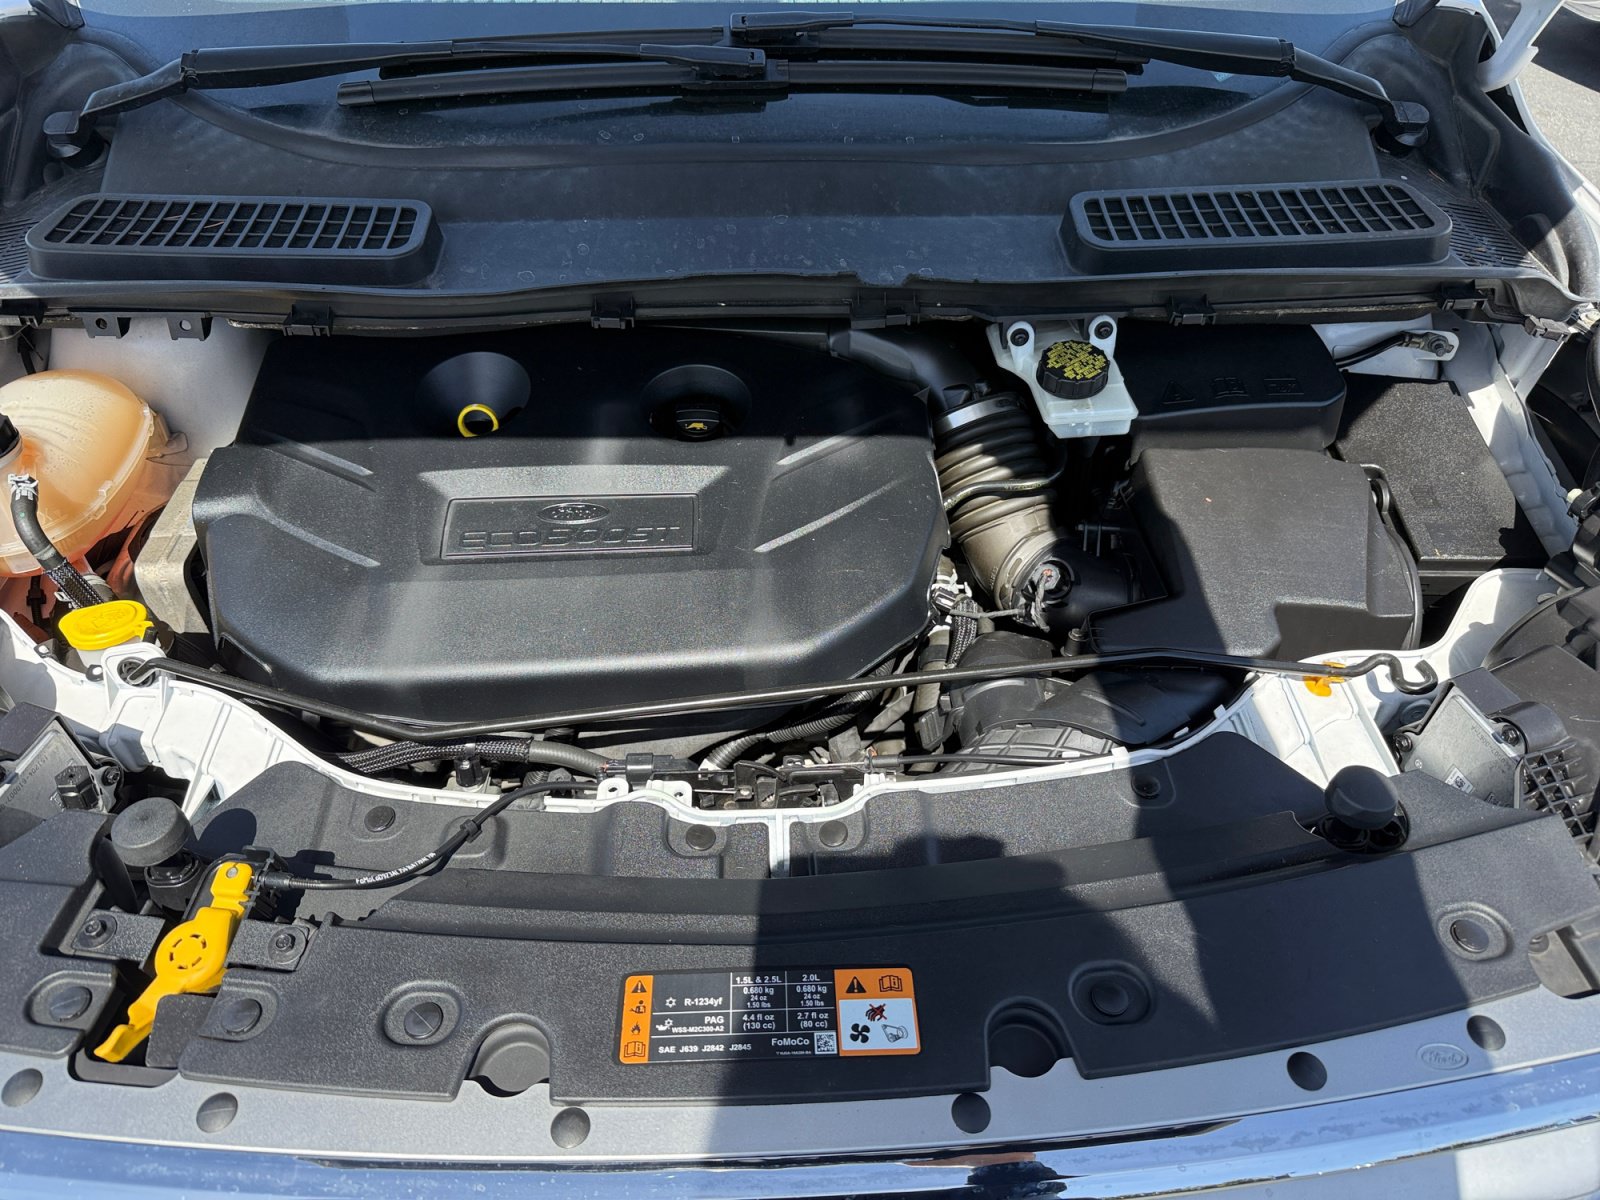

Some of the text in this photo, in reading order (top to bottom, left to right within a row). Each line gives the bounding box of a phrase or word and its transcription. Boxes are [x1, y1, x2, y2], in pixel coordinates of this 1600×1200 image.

[735, 975, 782, 984] 1.5L & 2.5L
[802, 974, 820, 982] 2.0L
[764, 987, 774, 995] kg
[796, 985, 827, 993] 0.680 kg
[684, 997, 723, 1008] R-1234yf
[704, 1015, 725, 1024] PAG
[756, 1013, 763, 1021] fl
[743, 1021, 776, 1031] (130 cc)
[800, 1020, 828, 1029] (80 cc)
[771, 1037, 810, 1046] FoMoCo
[679, 1045, 698, 1053] J639
[701, 1044, 725, 1052] J2842
